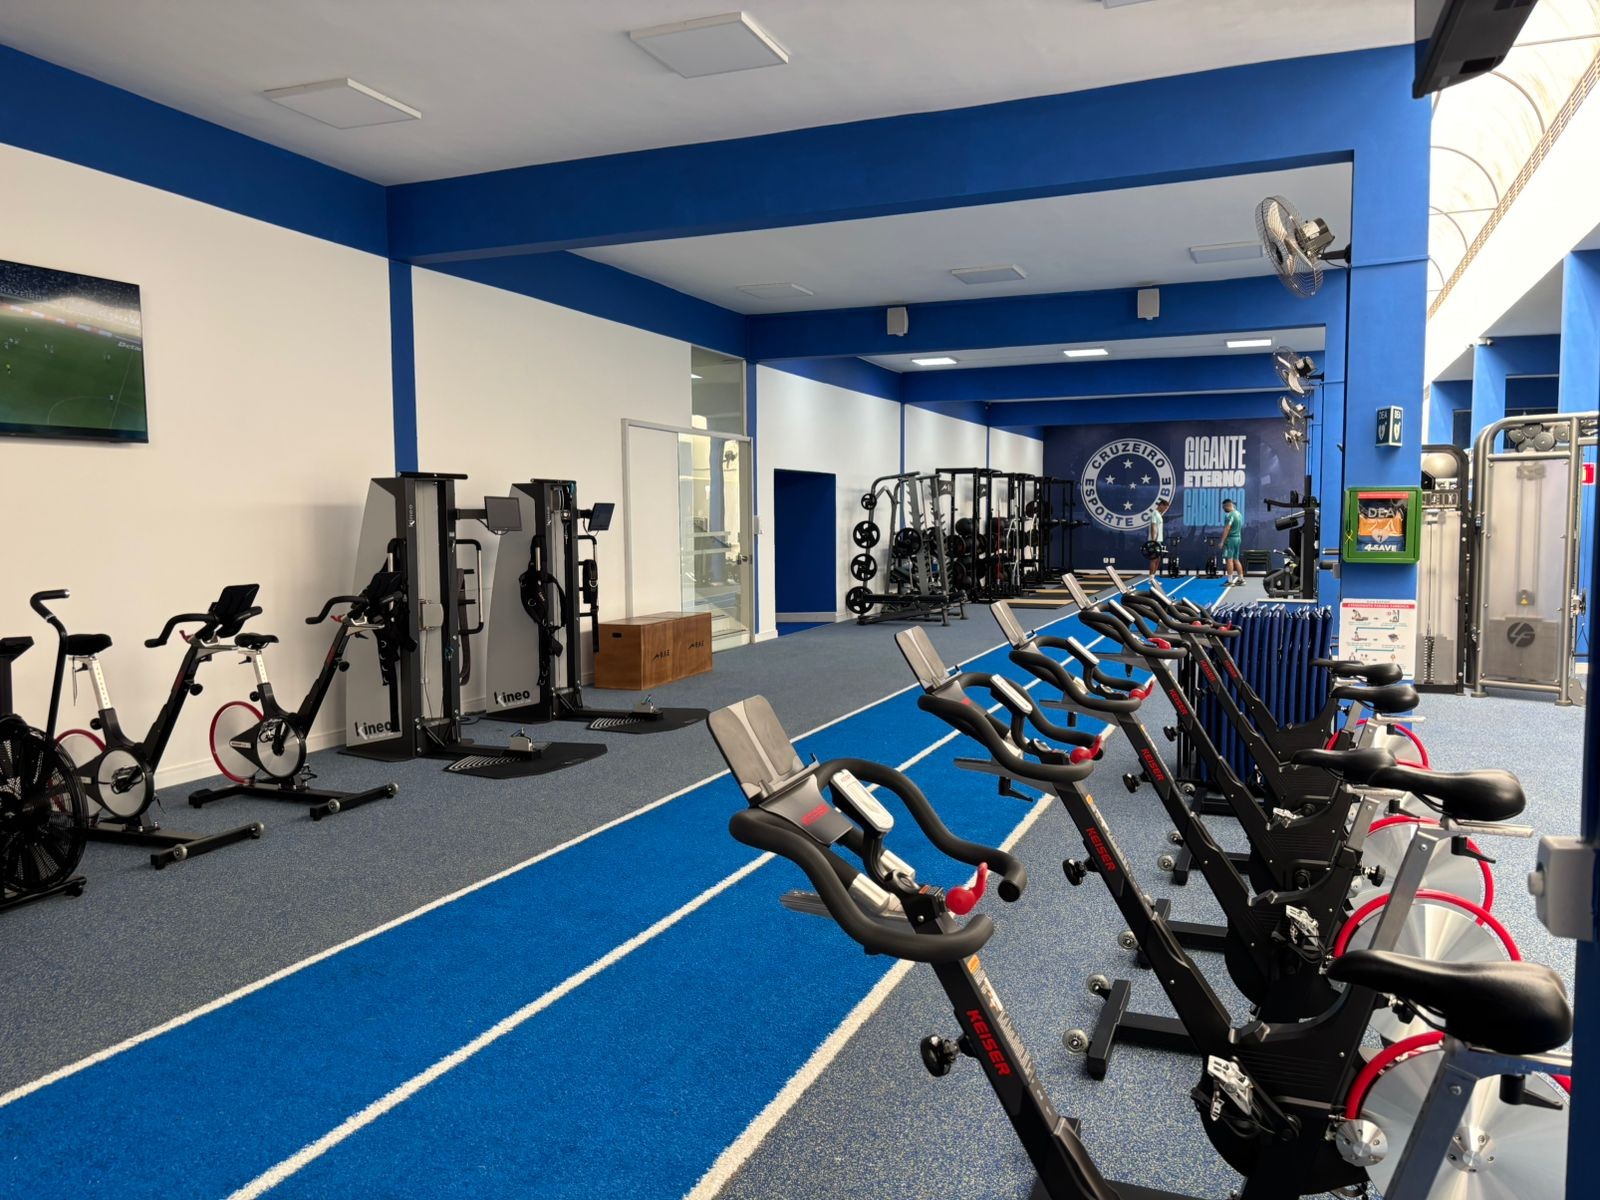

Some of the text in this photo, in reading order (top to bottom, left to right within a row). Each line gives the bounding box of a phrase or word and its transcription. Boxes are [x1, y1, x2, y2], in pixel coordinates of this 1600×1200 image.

[1091, 442, 1166, 470] CRUZEIRO
[1184, 435, 1247, 470] GIGANTE
[1183, 470, 1246, 488] ETERNO
[1084, 476, 1172, 527] ESPORTE CBE
[1368, 507, 1395, 518] DEA
[494, 690, 531, 708] kineo
[1141, 748, 1166, 781] KEISER
[1086, 827, 1117, 872] KEISER
[966, 1009, 1013, 1077] KEISER
